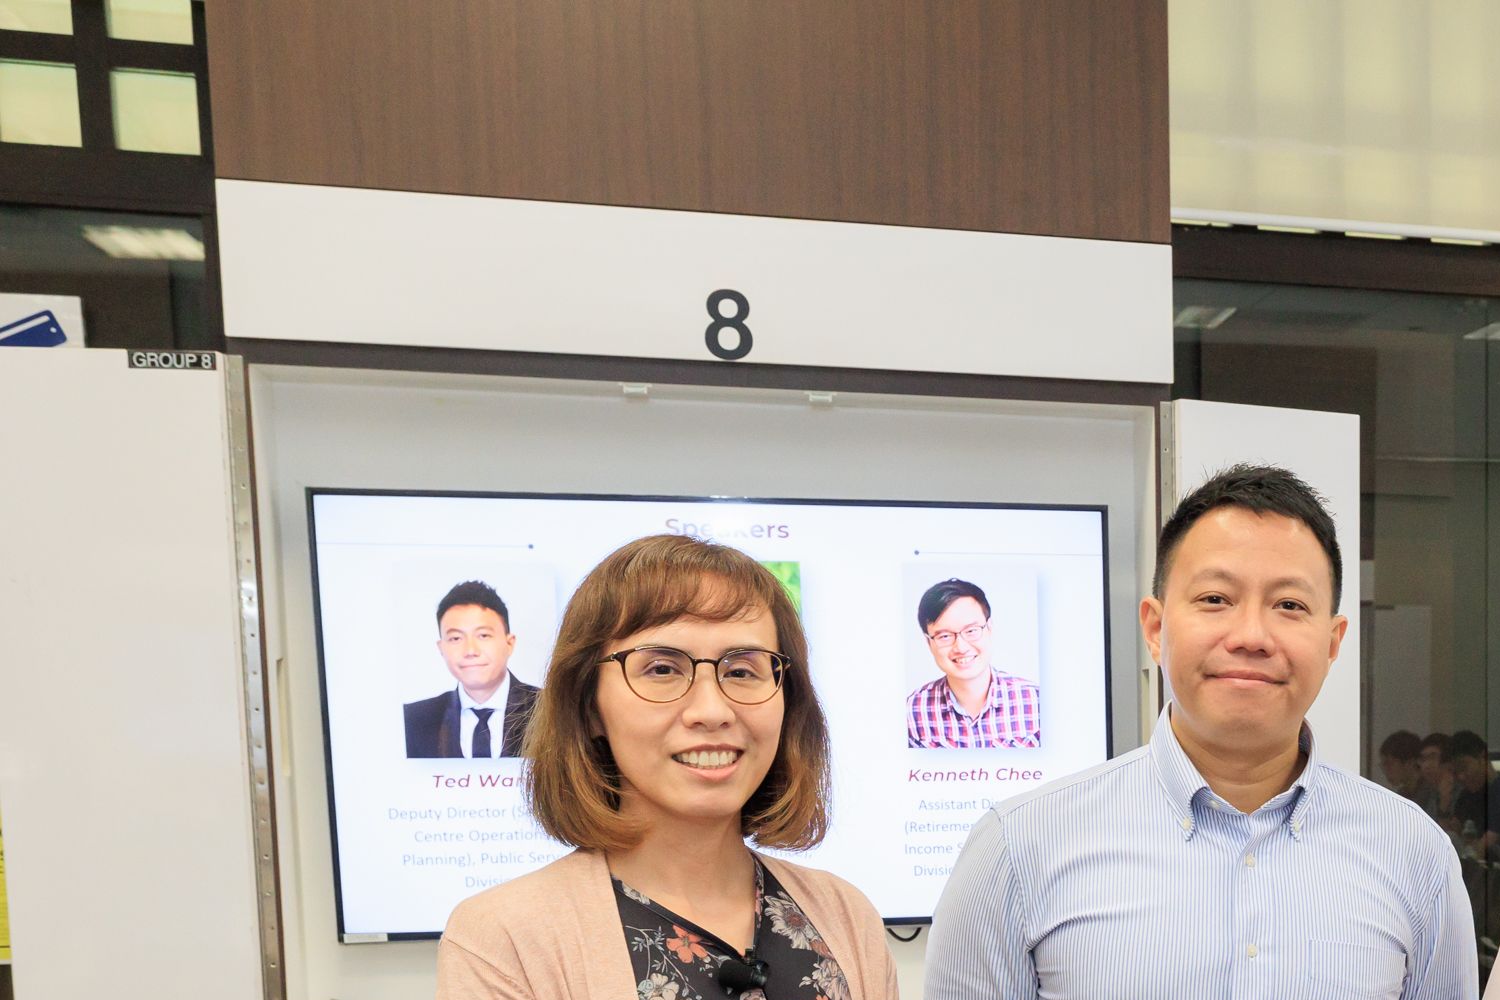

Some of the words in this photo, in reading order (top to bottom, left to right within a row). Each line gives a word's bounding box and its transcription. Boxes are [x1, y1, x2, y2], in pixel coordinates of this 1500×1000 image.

[705, 289, 753, 360] 8
[132, 351, 197, 368] GROUP
[201, 353, 212, 369] 8
[432, 773, 471, 789] Ted
[908, 768, 989, 782] Kenneth
[995, 767, 1043, 781] Chee
[918, 799, 977, 810] Assistant
[388, 807, 442, 821] Deputy
[447, 806, 507, 819] Director
[904, 821, 977, 835] (Retireme
[414, 830, 464, 843] Centre
[904, 843, 953, 855] Income
[402, 853, 476, 868] Planning),
[480, 851, 524, 865] Public
